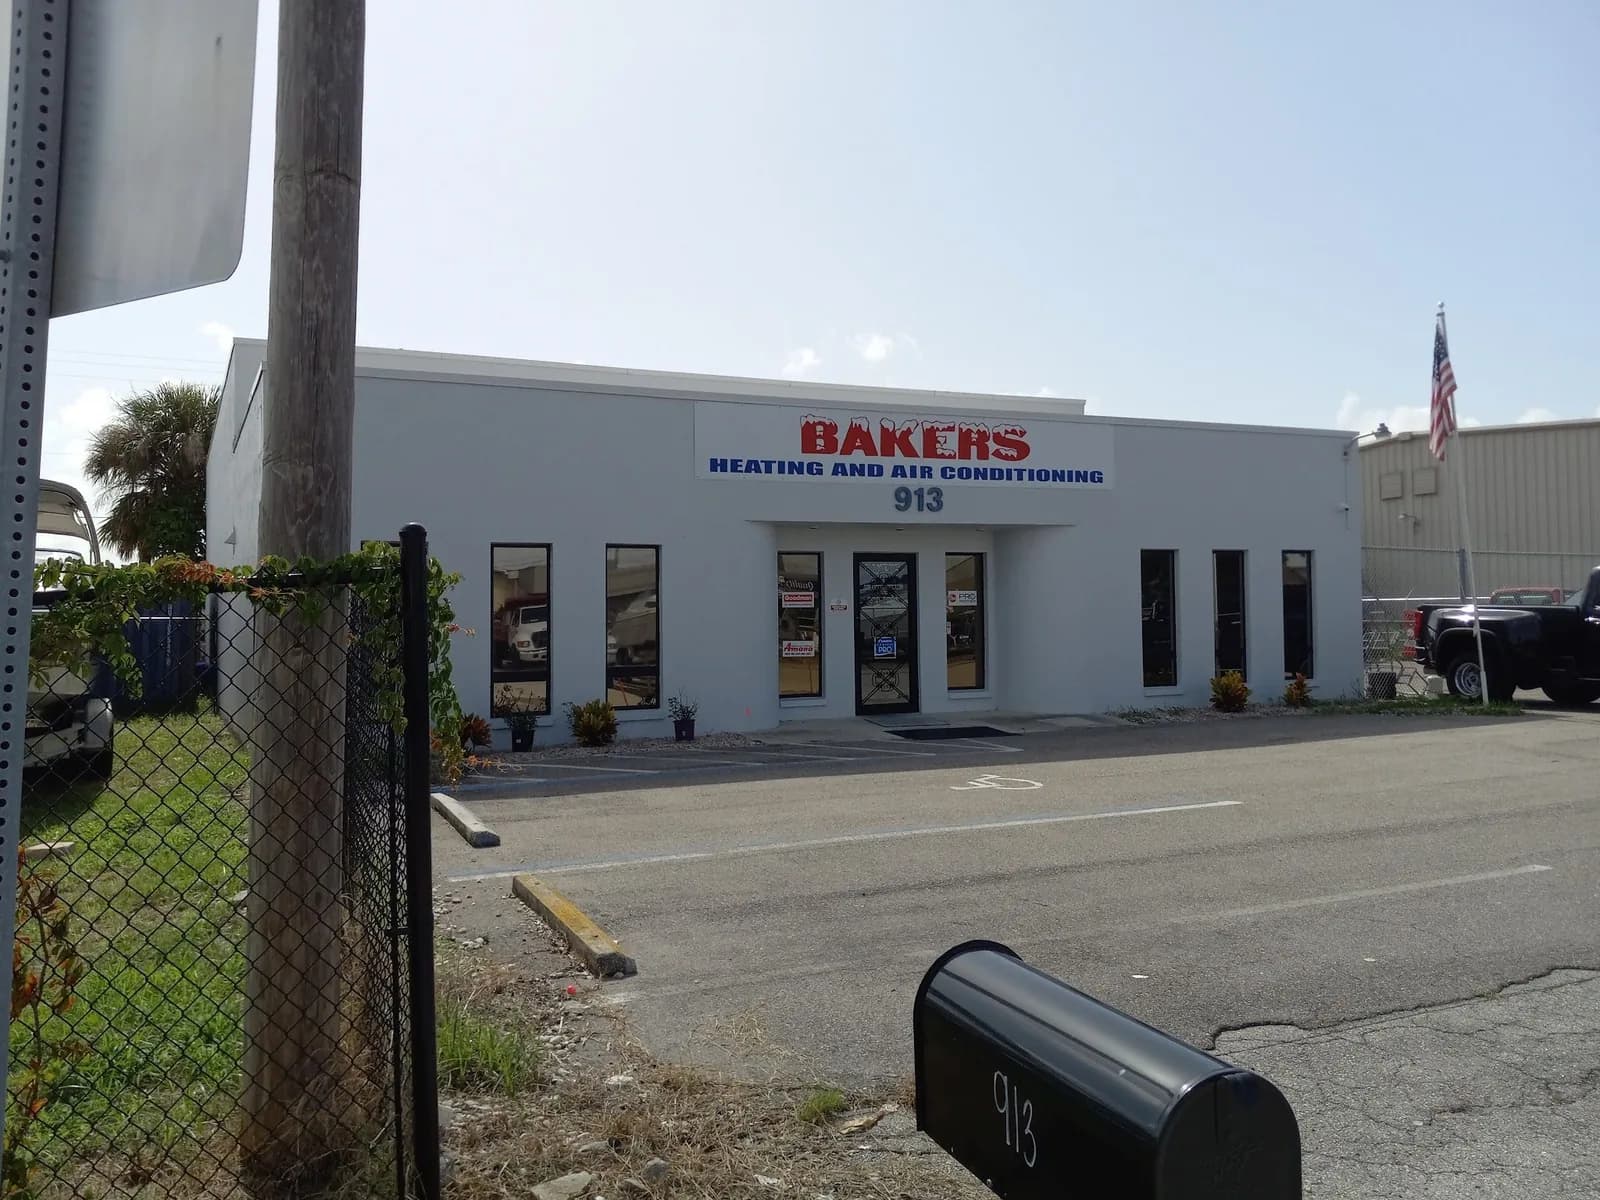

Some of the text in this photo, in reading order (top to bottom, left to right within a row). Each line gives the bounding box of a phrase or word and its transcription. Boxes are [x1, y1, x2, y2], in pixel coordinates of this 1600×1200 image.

[800, 413, 1031, 461] BAKERS
[709, 457, 1104, 484] HEATING AND AIR CONDITIONING
[894, 486, 944, 513] 913
[993, 1070, 1037, 1168] 913
